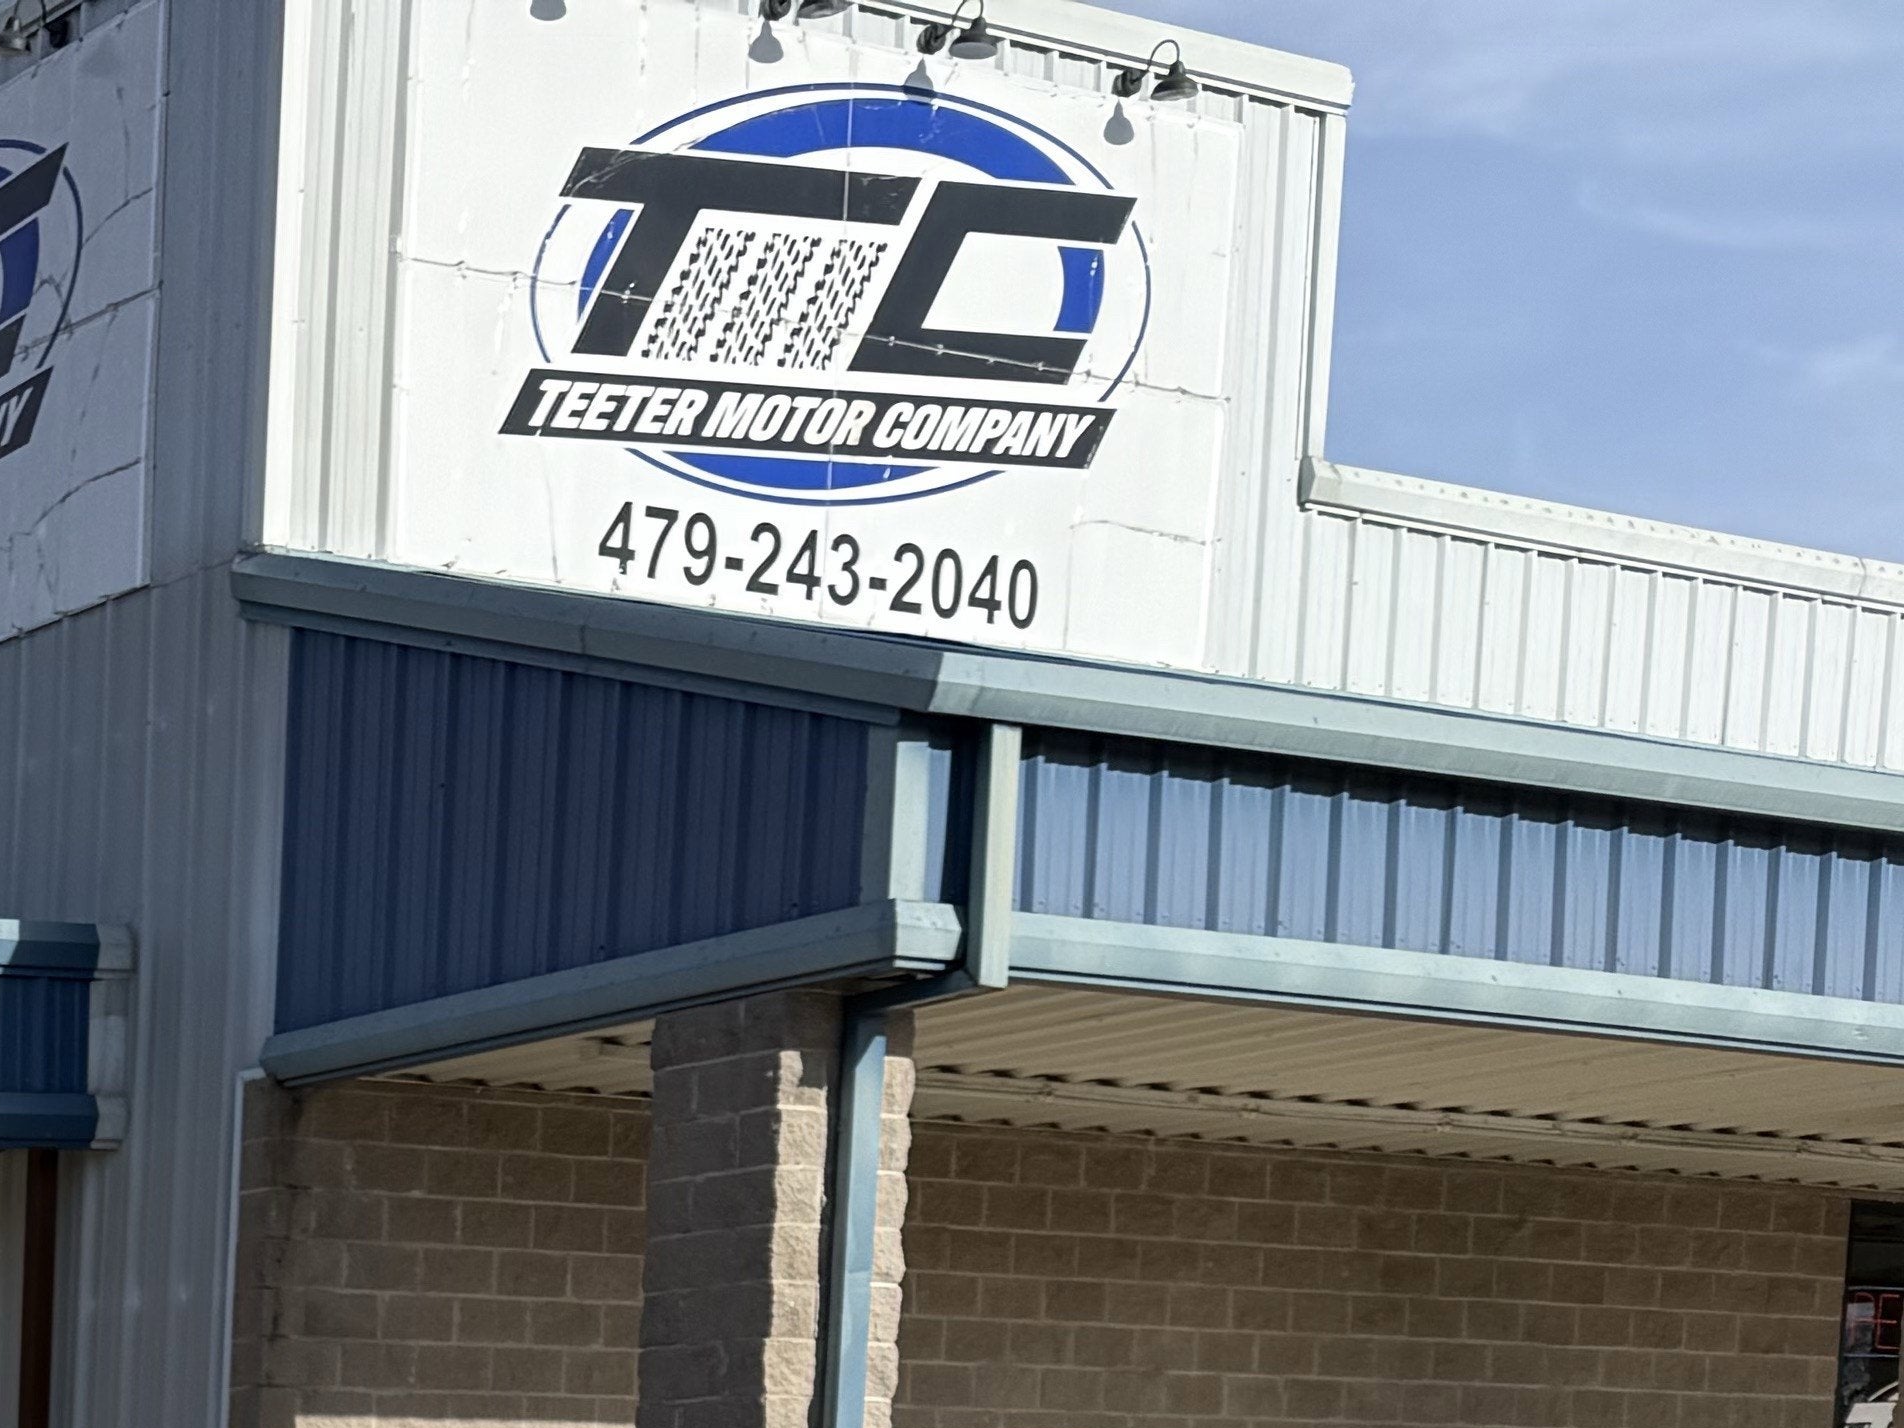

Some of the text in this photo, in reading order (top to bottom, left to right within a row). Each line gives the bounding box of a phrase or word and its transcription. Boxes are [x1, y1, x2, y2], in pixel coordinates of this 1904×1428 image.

[528, 379, 1094, 460] TEETER MOTOR COMPANY
[598, 502, 1039, 630] 479-243-2040
